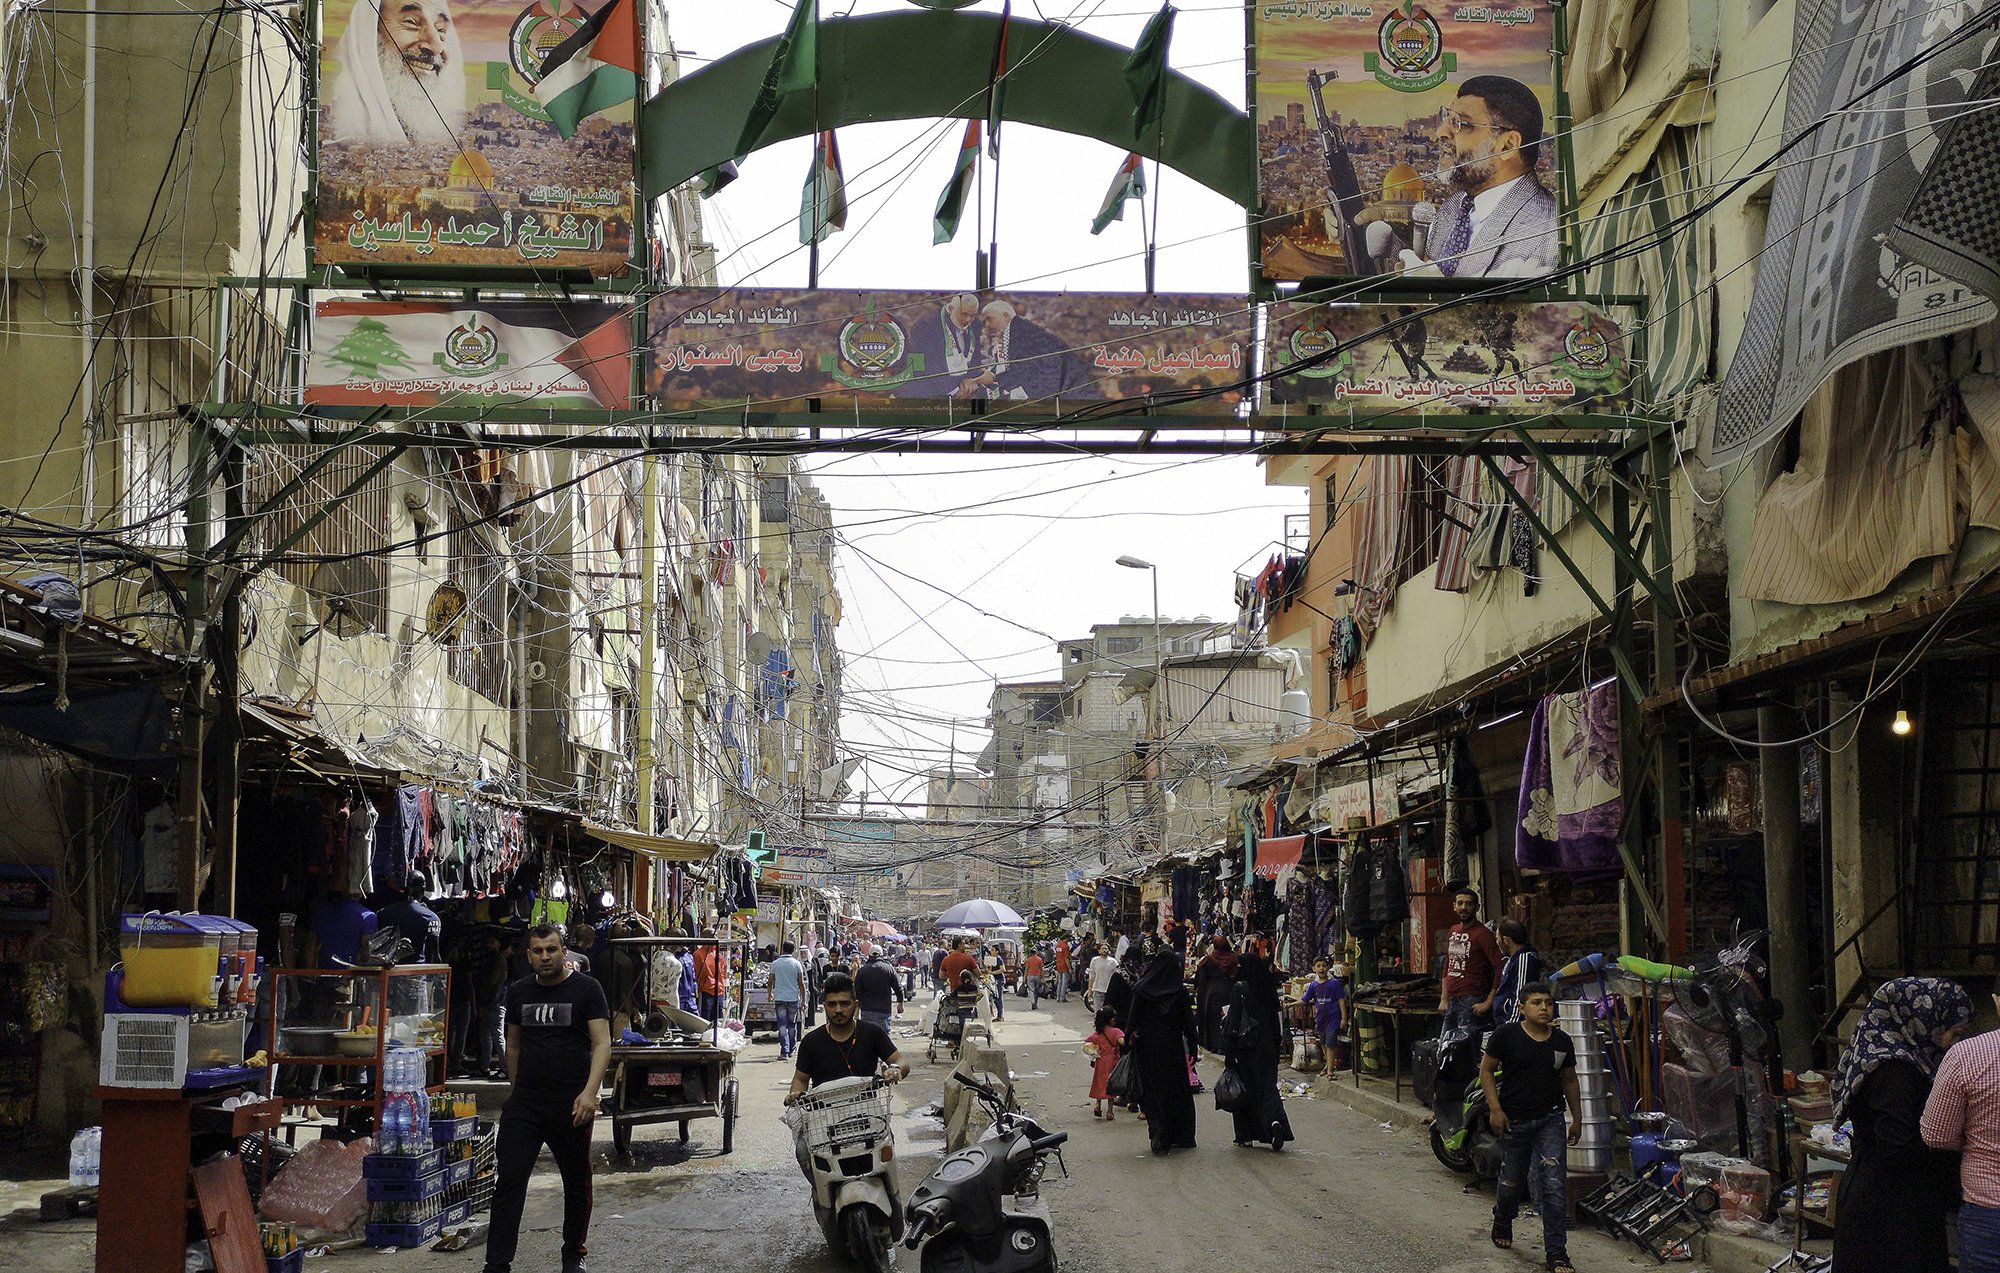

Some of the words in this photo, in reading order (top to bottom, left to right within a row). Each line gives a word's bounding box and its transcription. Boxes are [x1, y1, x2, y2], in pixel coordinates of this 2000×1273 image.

[1314, 1, 1349, 21] العزيز
[1350, 4, 1373, 21] عبد
[1454, 6, 1491, 23] القائد
[1493, 7, 1535, 27] الشهيد
[528, 186, 572, 204] القائد
[573, 187, 620, 208] الشهيد
[348, 209, 433, 255] ياسين
[437, 210, 513, 247] أحمد
[517, 213, 604, 259] الشيخ
[683, 307, 743, 328] المجاهد
[747, 306, 798, 325] القائد
[1108, 309, 1166, 330] المجاهد
[1171, 309, 1221, 326] القائد
[660, 344, 743, 372] السنوار
[746, 349, 803, 373] يحيى
[1092, 345, 1145, 376] هنية
[1149, 342, 1241, 376] أسماعيل
[458, 381, 483, 394] وجه
[483, 380, 499, 396] في
[500, 381, 533, 395] لبنان
[544, 379, 590, 395] فلسطين
[1335, 378, 1390, 400] القسام
[1394, 380, 1439, 401] الدين
[1444, 378, 1466, 400] عز
[1470, 378, 1518, 400] كتائب
[1521, 377, 1576, 402] فلتحيا
